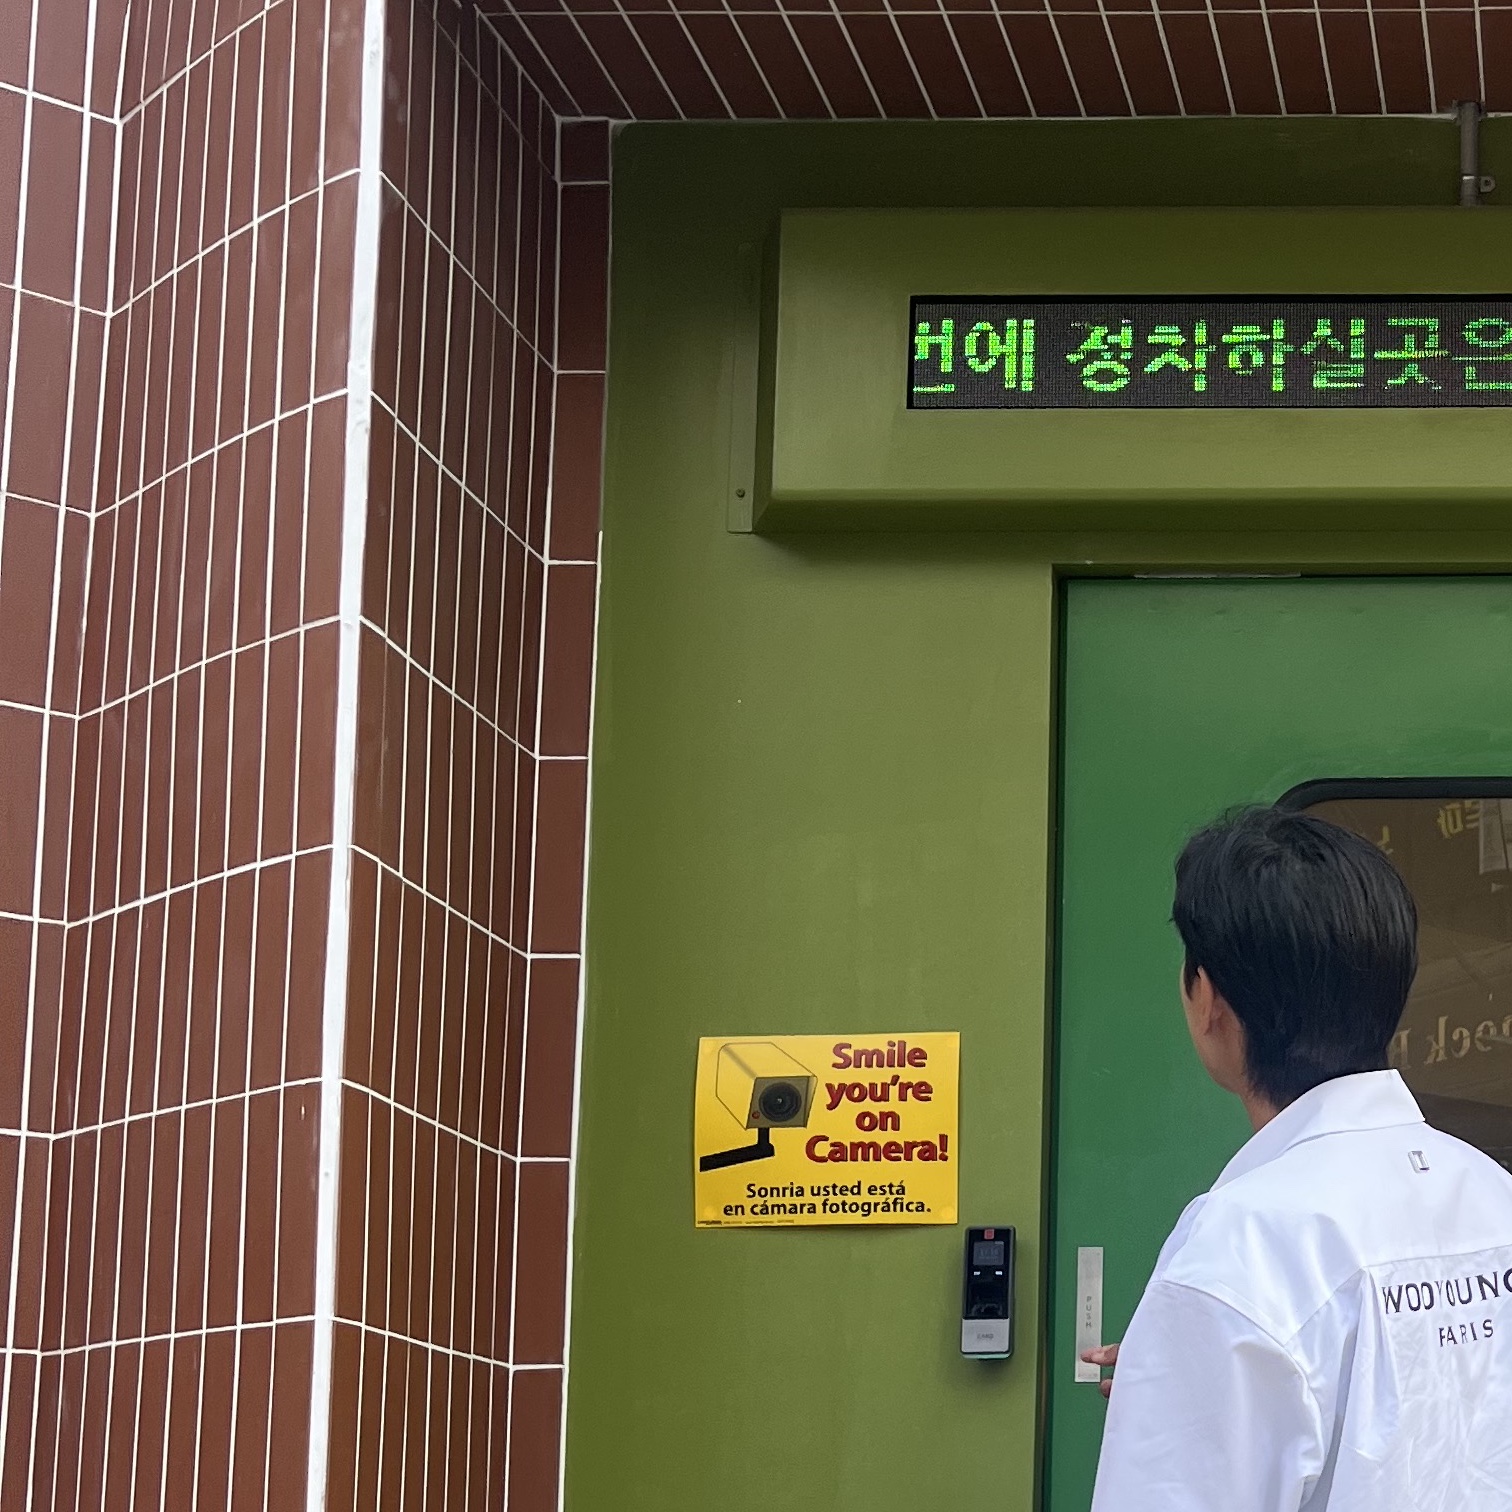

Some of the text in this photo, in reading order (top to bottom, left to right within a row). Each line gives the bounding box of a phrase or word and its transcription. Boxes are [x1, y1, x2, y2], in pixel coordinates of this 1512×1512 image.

[832, 1040, 928, 1070] Smile
[825, 1075, 934, 1110] you're
[855, 1110, 901, 1132] on
[805, 1133, 949, 1163] Camera!
[810, 1180, 862, 1197] usted
[867, 1179, 907, 1196] está
[723, 1196, 932, 1218] en cámara fotográfica.
